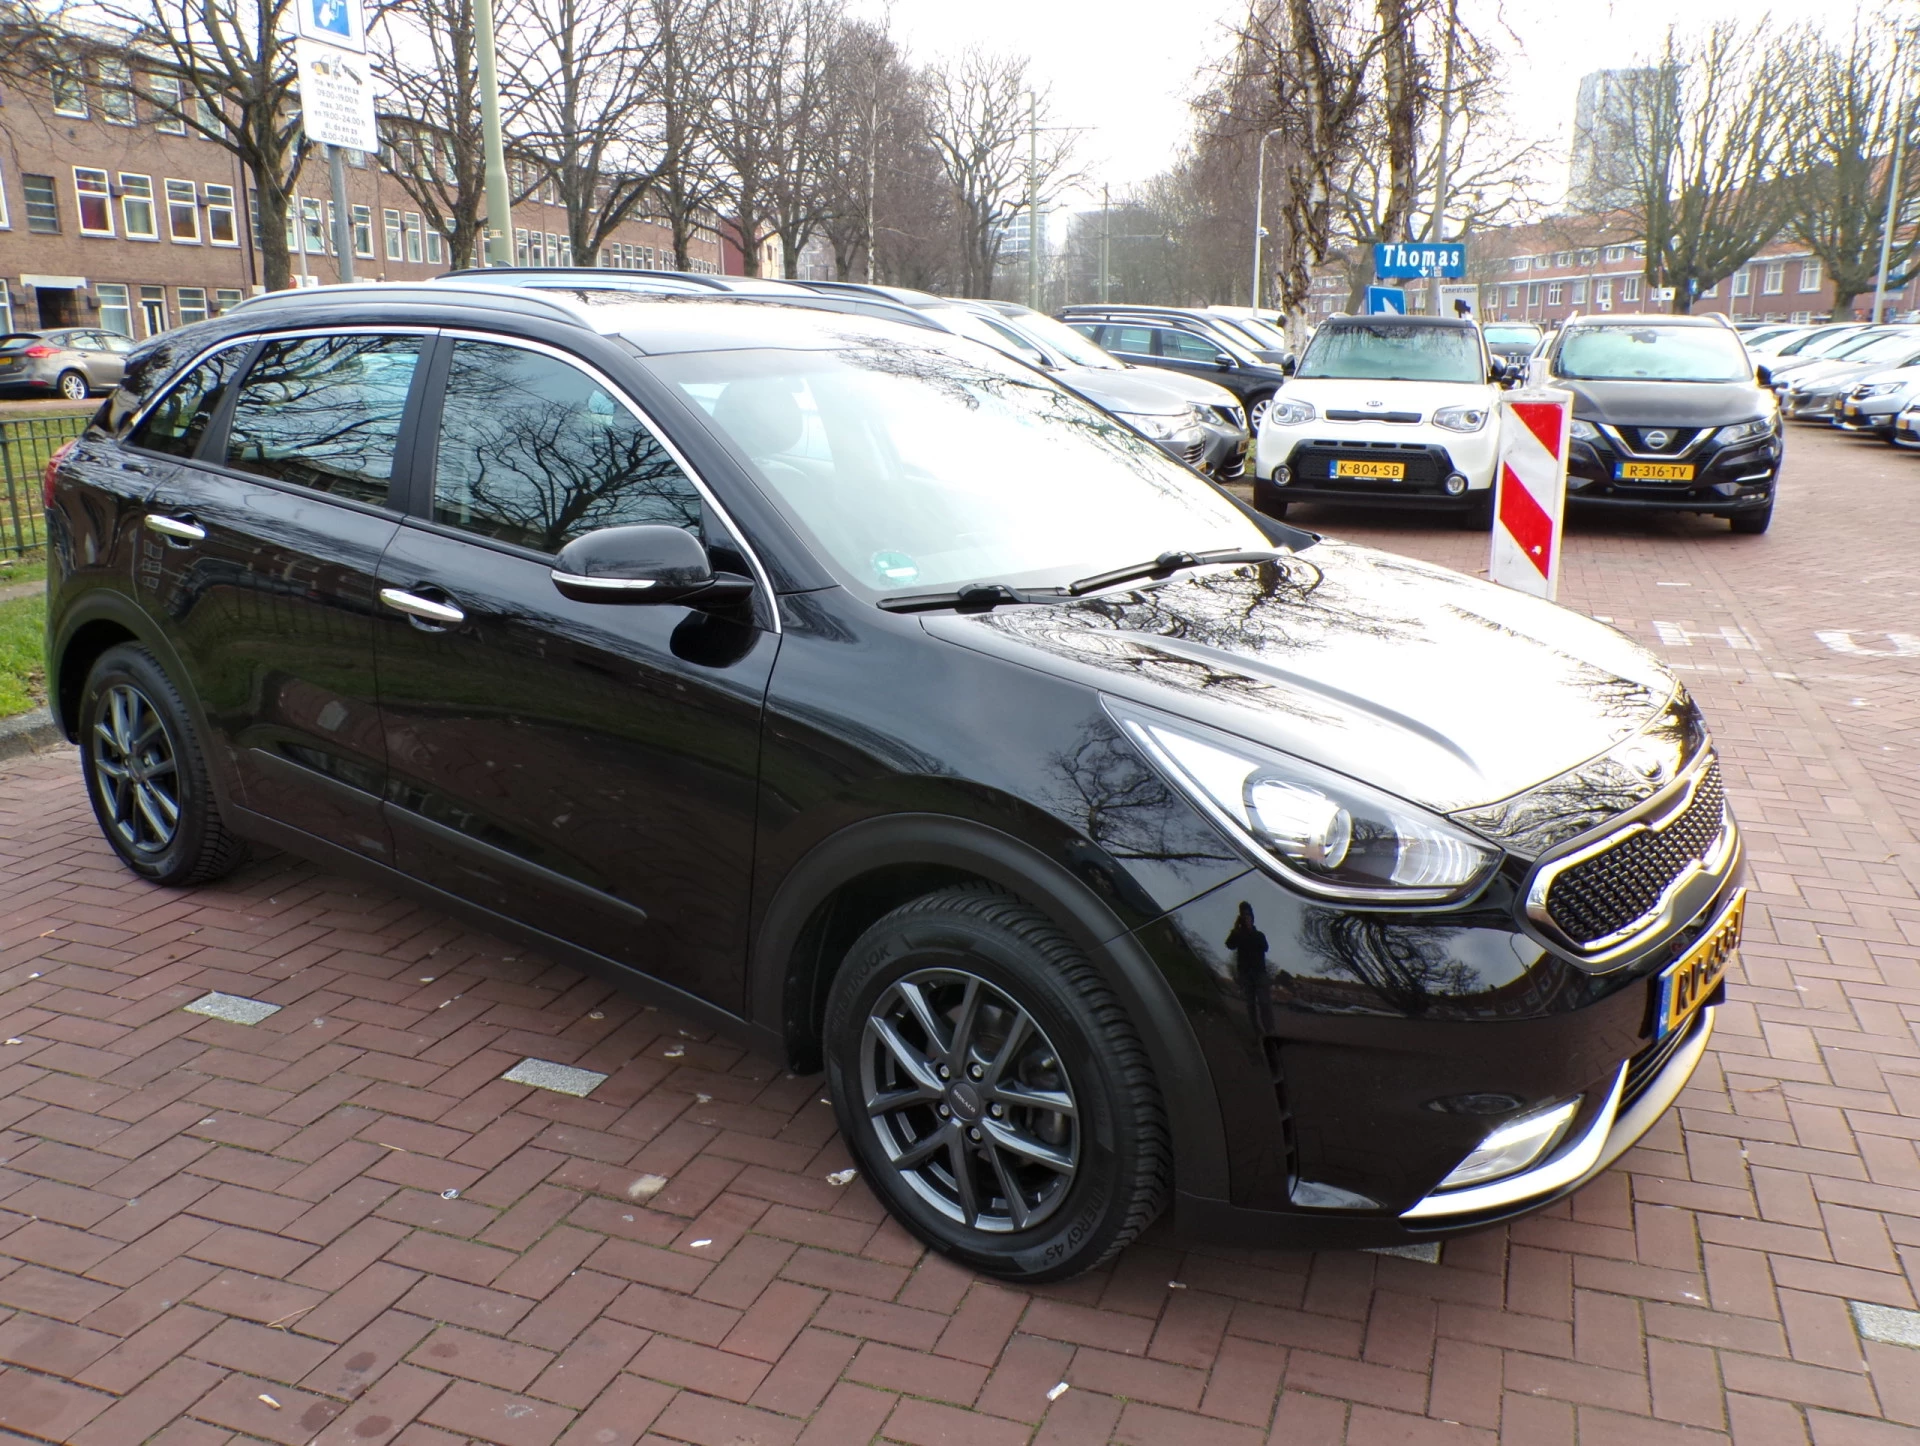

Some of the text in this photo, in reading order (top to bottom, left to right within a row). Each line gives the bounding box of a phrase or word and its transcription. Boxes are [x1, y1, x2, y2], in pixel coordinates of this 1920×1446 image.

[1383, 244, 1460, 267] Thomas
[1340, 463, 1400, 476] K-804-SB
[1629, 465, 1687, 478] R-316-TV
